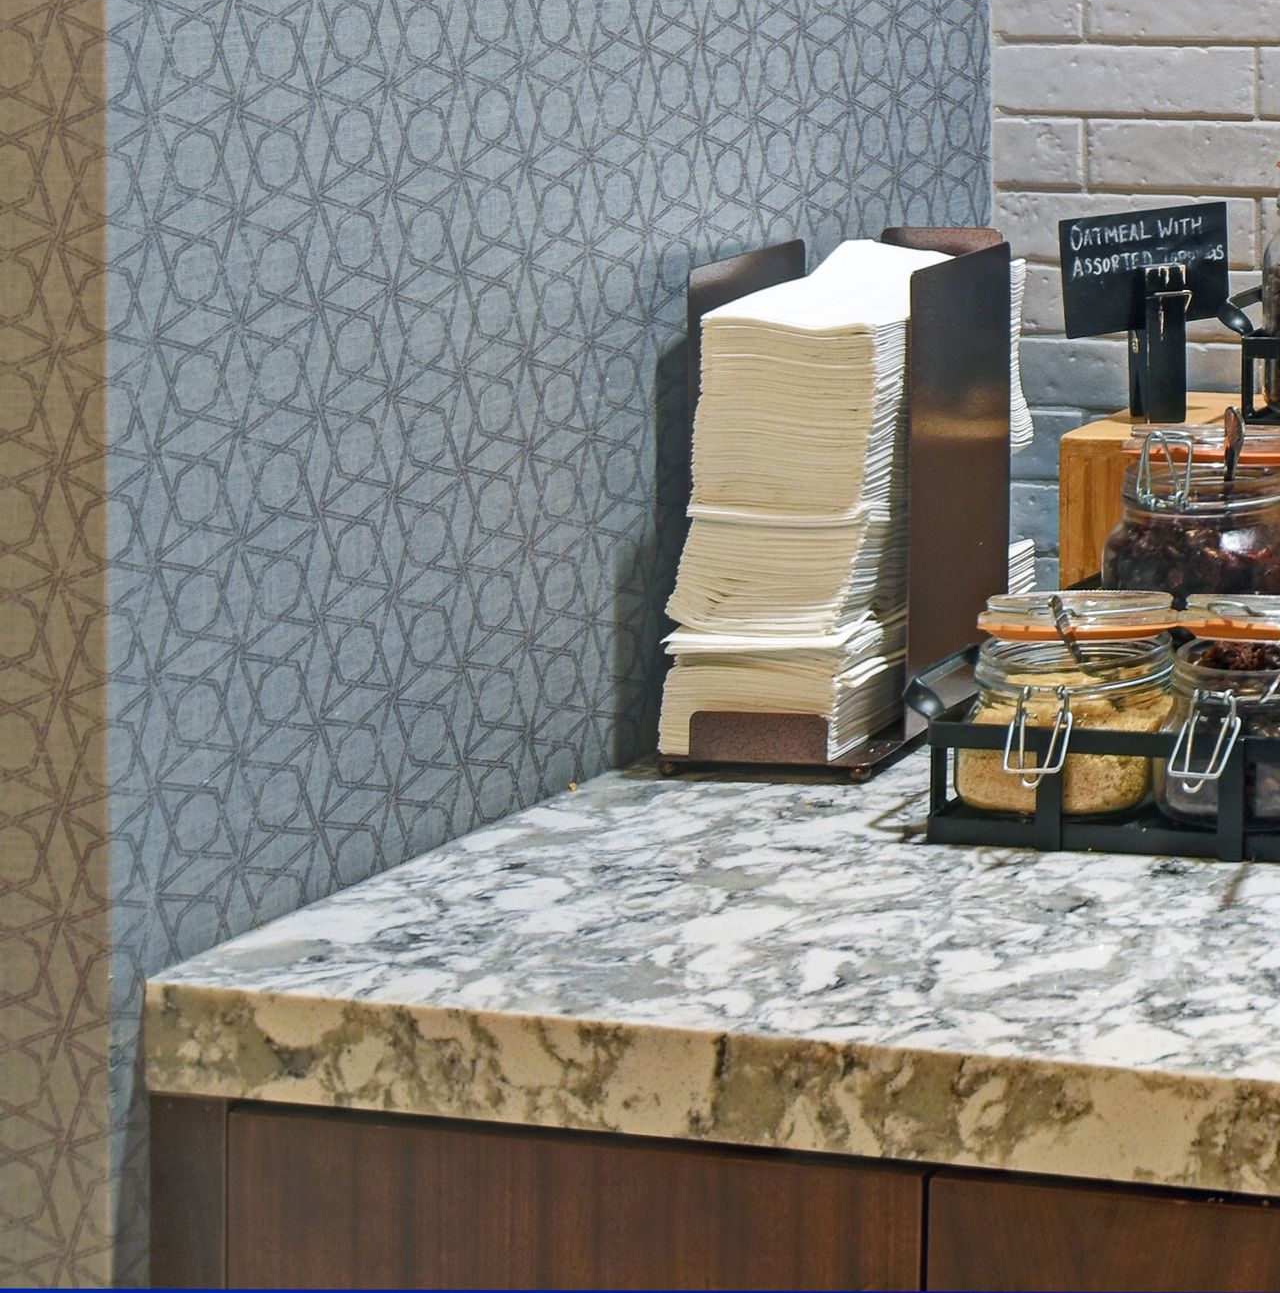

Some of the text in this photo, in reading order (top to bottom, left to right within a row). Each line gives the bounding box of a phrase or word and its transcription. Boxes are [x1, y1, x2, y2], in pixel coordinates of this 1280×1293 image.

[1070, 216, 1203, 251] OATMEAL WITH
[1071, 251, 1153, 279] ASSORTED
